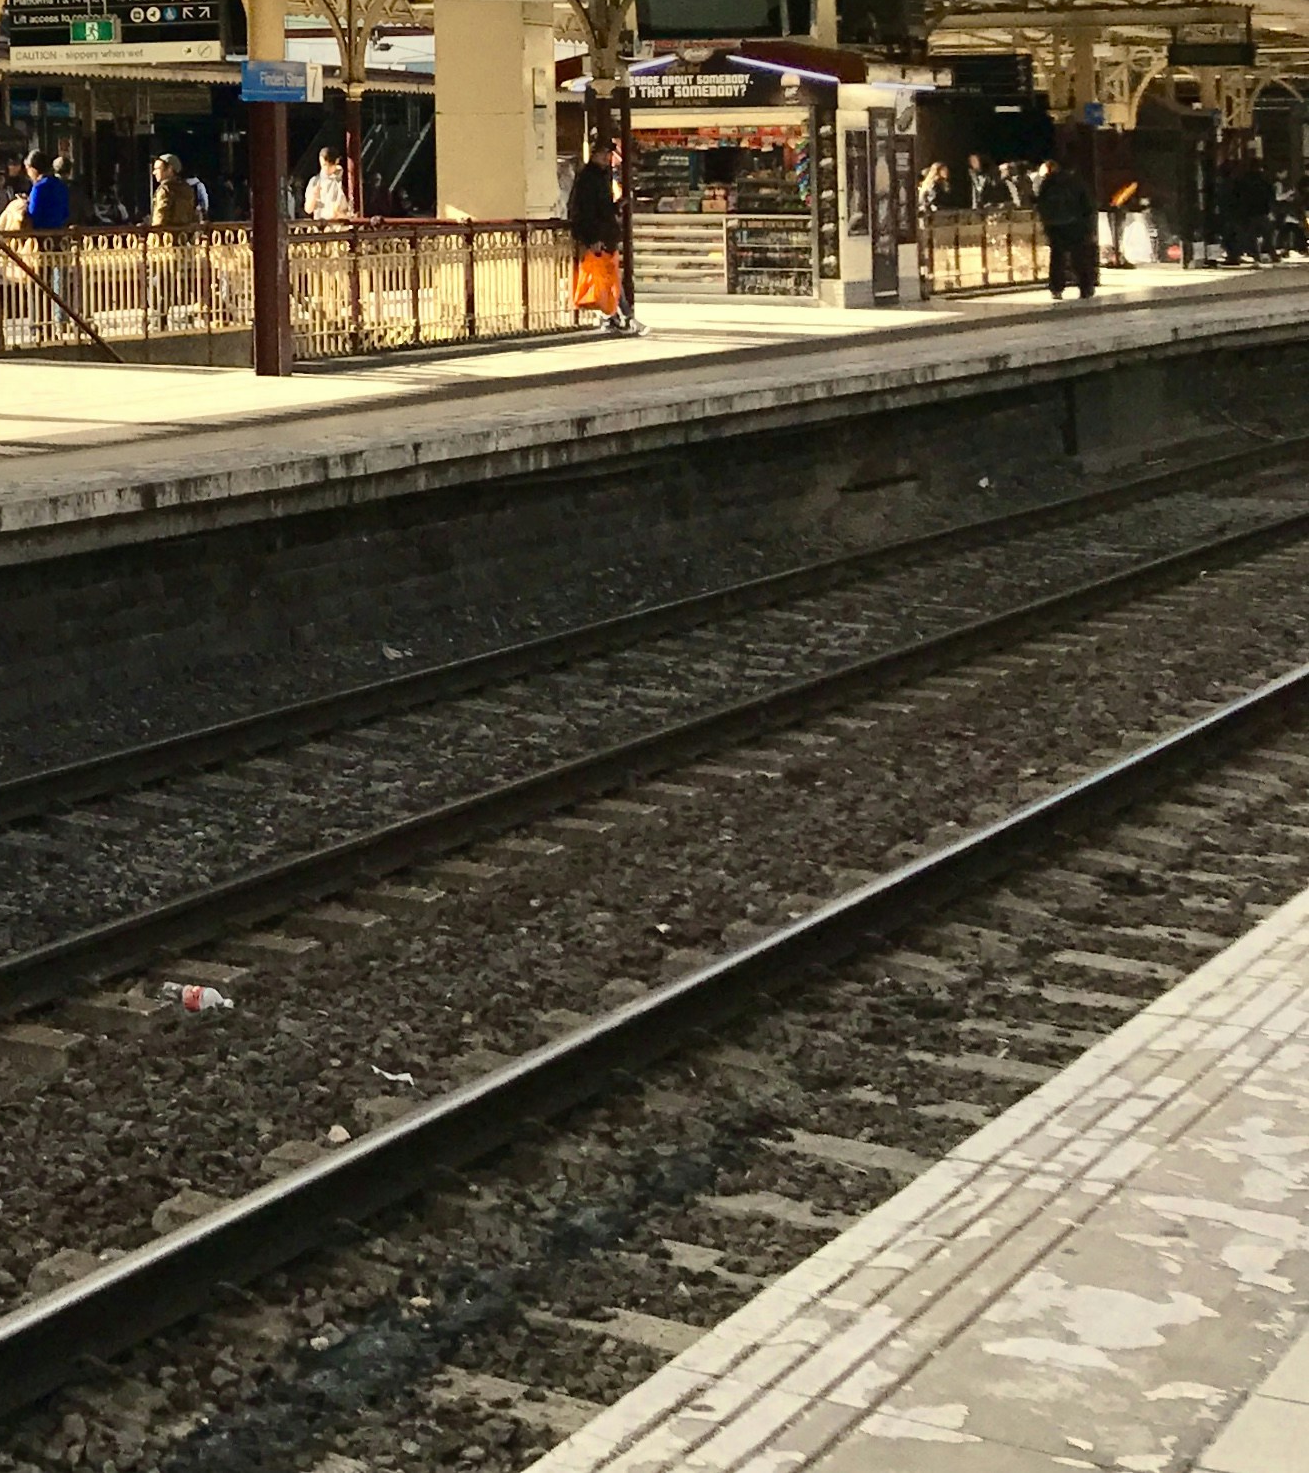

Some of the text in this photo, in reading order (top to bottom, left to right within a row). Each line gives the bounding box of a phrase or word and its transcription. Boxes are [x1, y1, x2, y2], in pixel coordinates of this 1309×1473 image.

[13, 14, 27, 25] Lift
[29, 14, 60, 24] access
[61, 14, 70, 24] to
[15, 50, 58, 62] CAUTION
[309, 66, 319, 98] 7
[662, 74, 694, 85] ABOUT
[641, 85, 671, 99] THAT
[674, 84, 747, 98] SOMEBODY?
